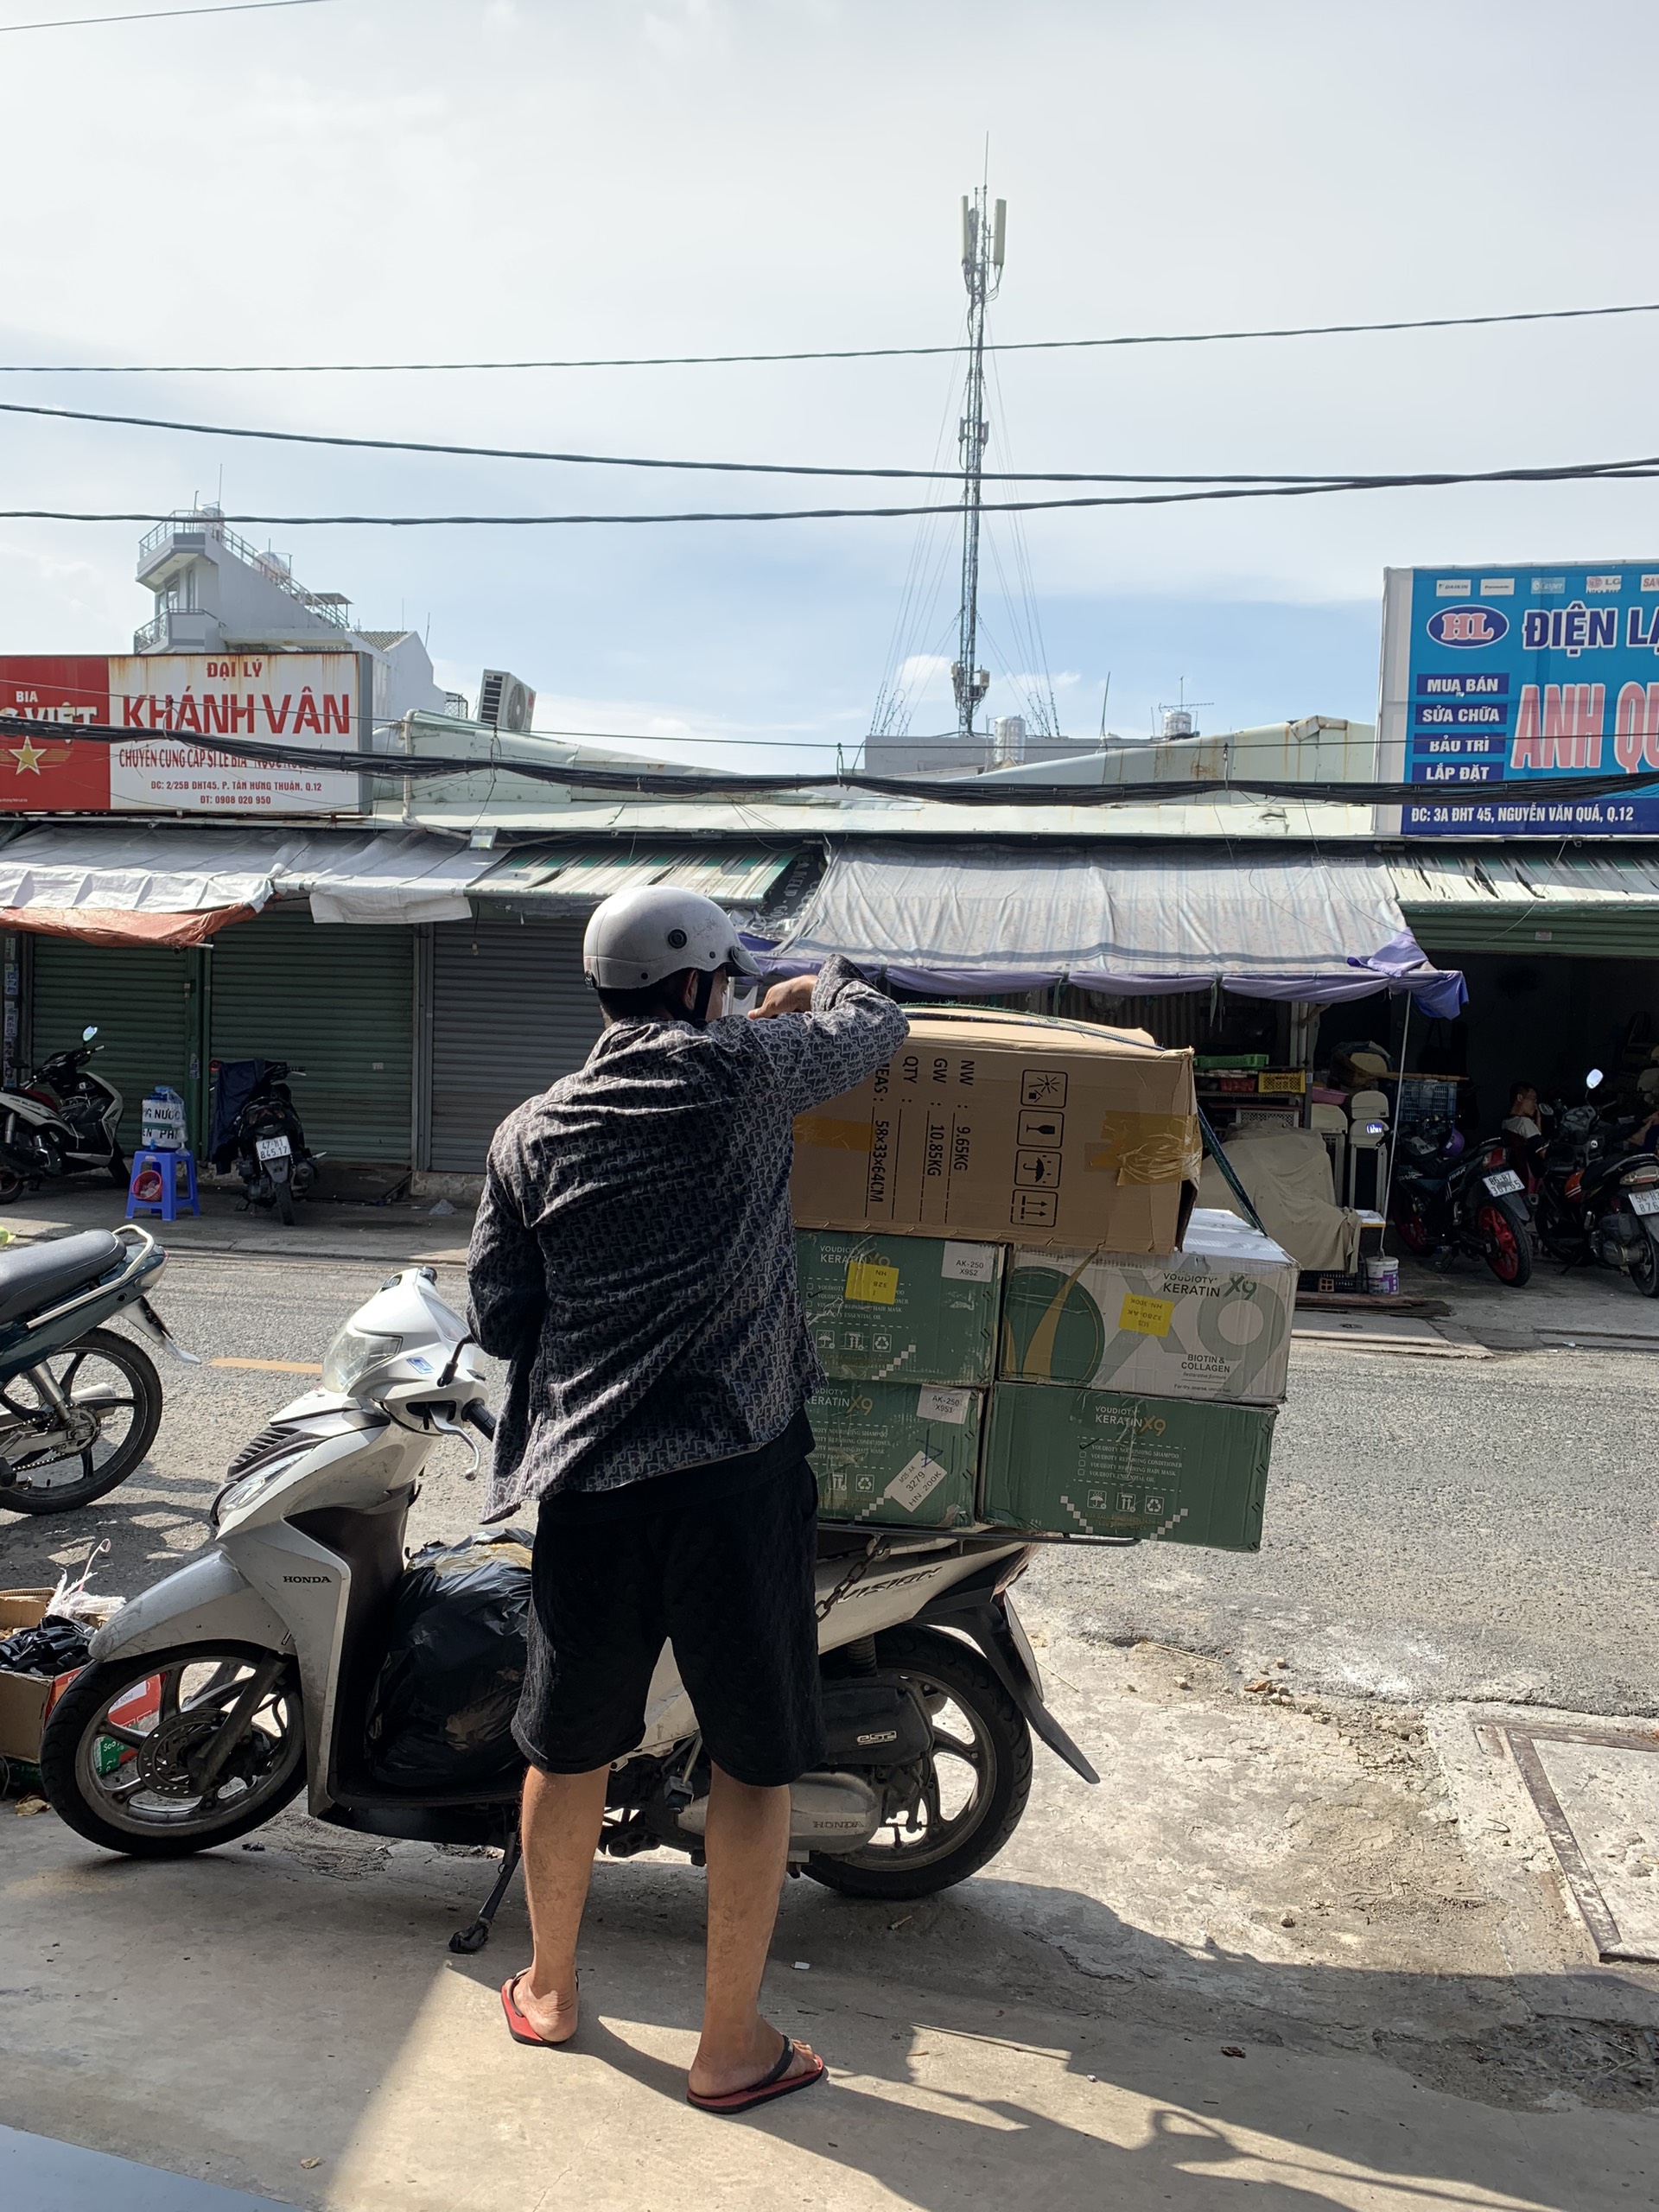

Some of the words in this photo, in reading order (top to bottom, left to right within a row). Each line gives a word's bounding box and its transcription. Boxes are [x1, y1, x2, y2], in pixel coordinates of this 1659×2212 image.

[1605, 577, 1621, 586] LG
[1441, 613, 1494, 640] HL
[1522, 601, 1618, 657] ĐIỆN
[207, 662, 236, 681] ĐẠI
[243, 658, 263, 677] LÝ
[1427, 679, 1461, 692] MUA
[1466, 676, 1498, 691] BÁN
[16, 690, 38, 702] BIA
[123, 685, 255, 734] KHÁNH
[262, 686, 350, 734] VÂN
[1422, 705, 1453, 721] SỬA
[1458, 706, 1500, 722] CHỮA
[1510, 683, 1605, 769] ANH
[159, 748, 185, 768] CUNG
[1426, 762, 1456, 780] LẮP
[1459, 764, 1490, 782] ĐẶT
[232, 779, 247, 791] TÂN
[306, 782, 322, 791] Q.12
[214, 795, 236, 804] 0908
[238, 795, 253, 804] 020
[256, 795, 271, 805] 950
[1411, 807, 1431, 822] ĐC:
[1433, 807, 1449, 822] 3A
[1452, 807, 1474, 822] ĐHT
[1476, 807, 1495, 823] 45,
[1497, 801, 1545, 822] NGUYỄN
[1548, 804, 1573, 822] VĂN
[1575, 804, 1604, 823] QUÁ,
[1606, 806, 1634, 823] Q.12
[902, 1056, 918, 1084] QTY
[932, 1058, 948, 1084] GW
[959, 1059, 975, 1086] NW
[927, 1124, 945, 1177] 10.85KG
[954, 1126, 971, 1171] 9.65KG
[955, 1259, 984, 1269] AK-250
[959, 1268, 979, 1276] X9S2
[1162, 1283, 1220, 1297] KERATIN
[1180, 1362, 1230, 1373] COLLAGEN
[1187, 1354, 1217, 1363] BIOTIN
[847, 1394, 874, 1415] X9
[932, 1395, 960, 1406] AK-250
[1095, 1405, 1137, 1416] VOUDIOTY
[1095, 1414, 1143, 1427] KERATIN
[1140, 1415, 1166, 1437] X9
[906, 1471, 926, 1492] 3279
[283, 1575, 333, 1584] HONDA
[836, 1566, 943, 1605] VISION
[812, 1821, 865, 1829] HONDA
